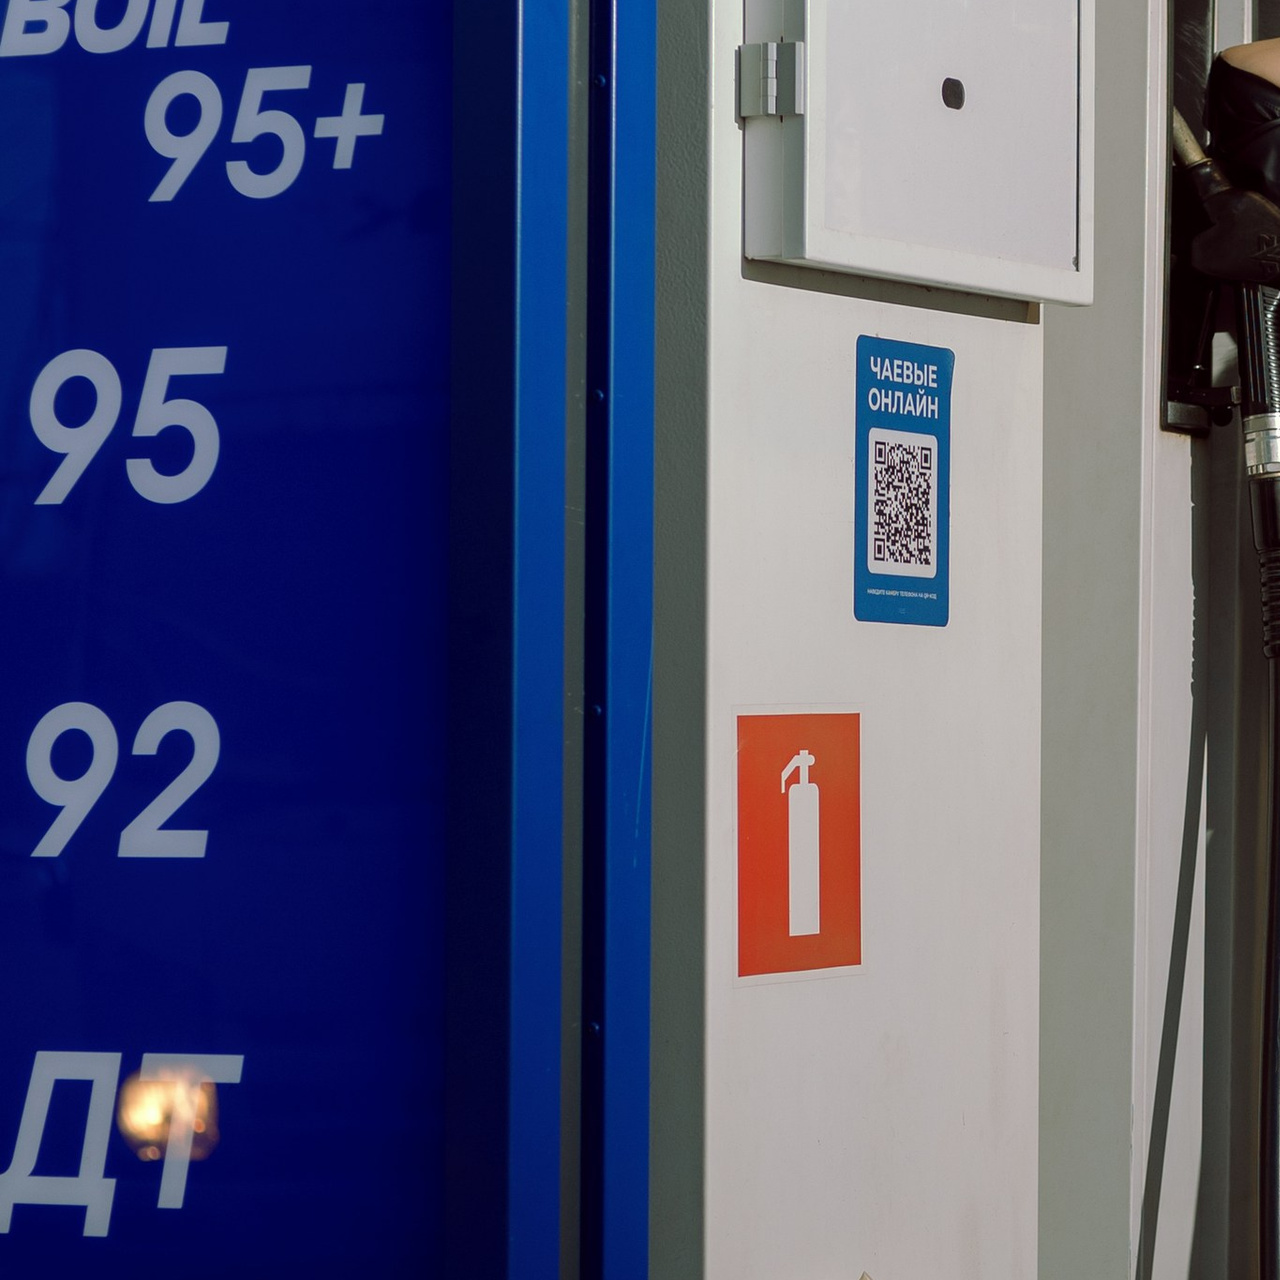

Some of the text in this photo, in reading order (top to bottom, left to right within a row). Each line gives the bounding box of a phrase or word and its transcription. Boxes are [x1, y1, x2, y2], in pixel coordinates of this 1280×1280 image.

[144, 64, 385, 202] 95+
[29, 345, 228, 505] 95
[868, 387, 939, 419] ОНЛАЙН
[870, 356, 938, 388] ЧАЕВЫЕ
[25, 700, 221, 858] 92
[0, 1051, 245, 1237] ДТ
